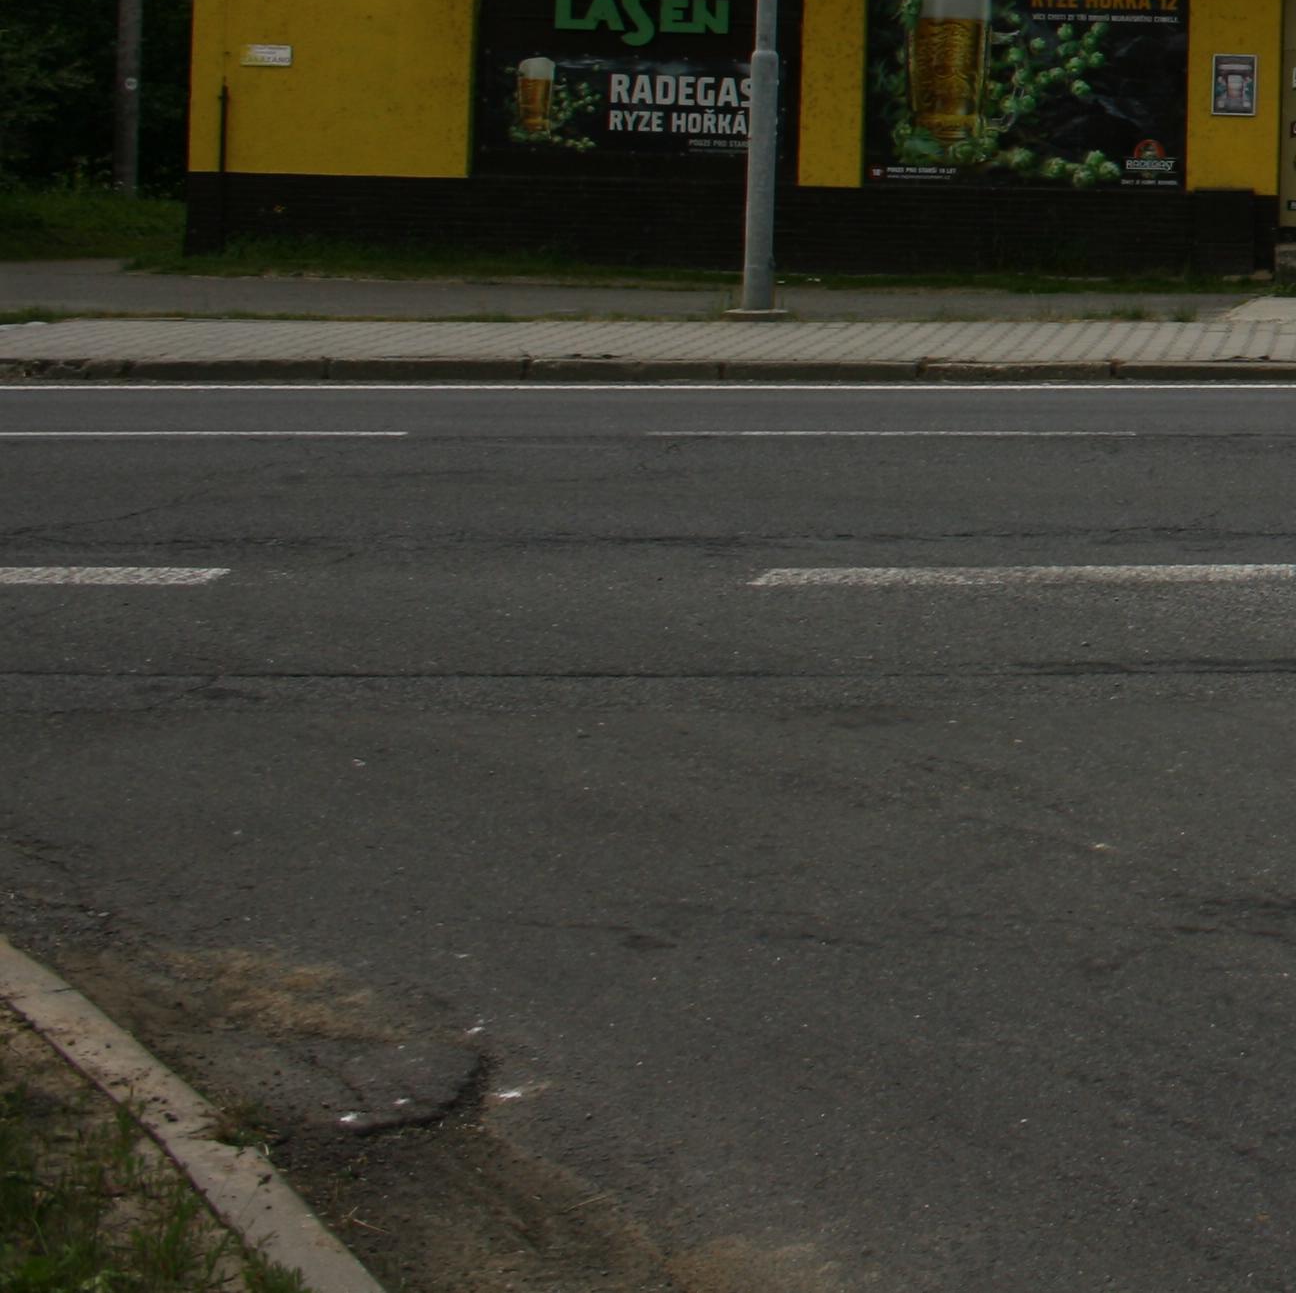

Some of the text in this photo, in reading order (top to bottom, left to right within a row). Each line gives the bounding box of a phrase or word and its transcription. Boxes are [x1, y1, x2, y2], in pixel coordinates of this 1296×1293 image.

[610, 73, 752, 107] RADEGAS
[609, 108, 748, 135] RYZE HOŘKÁ
